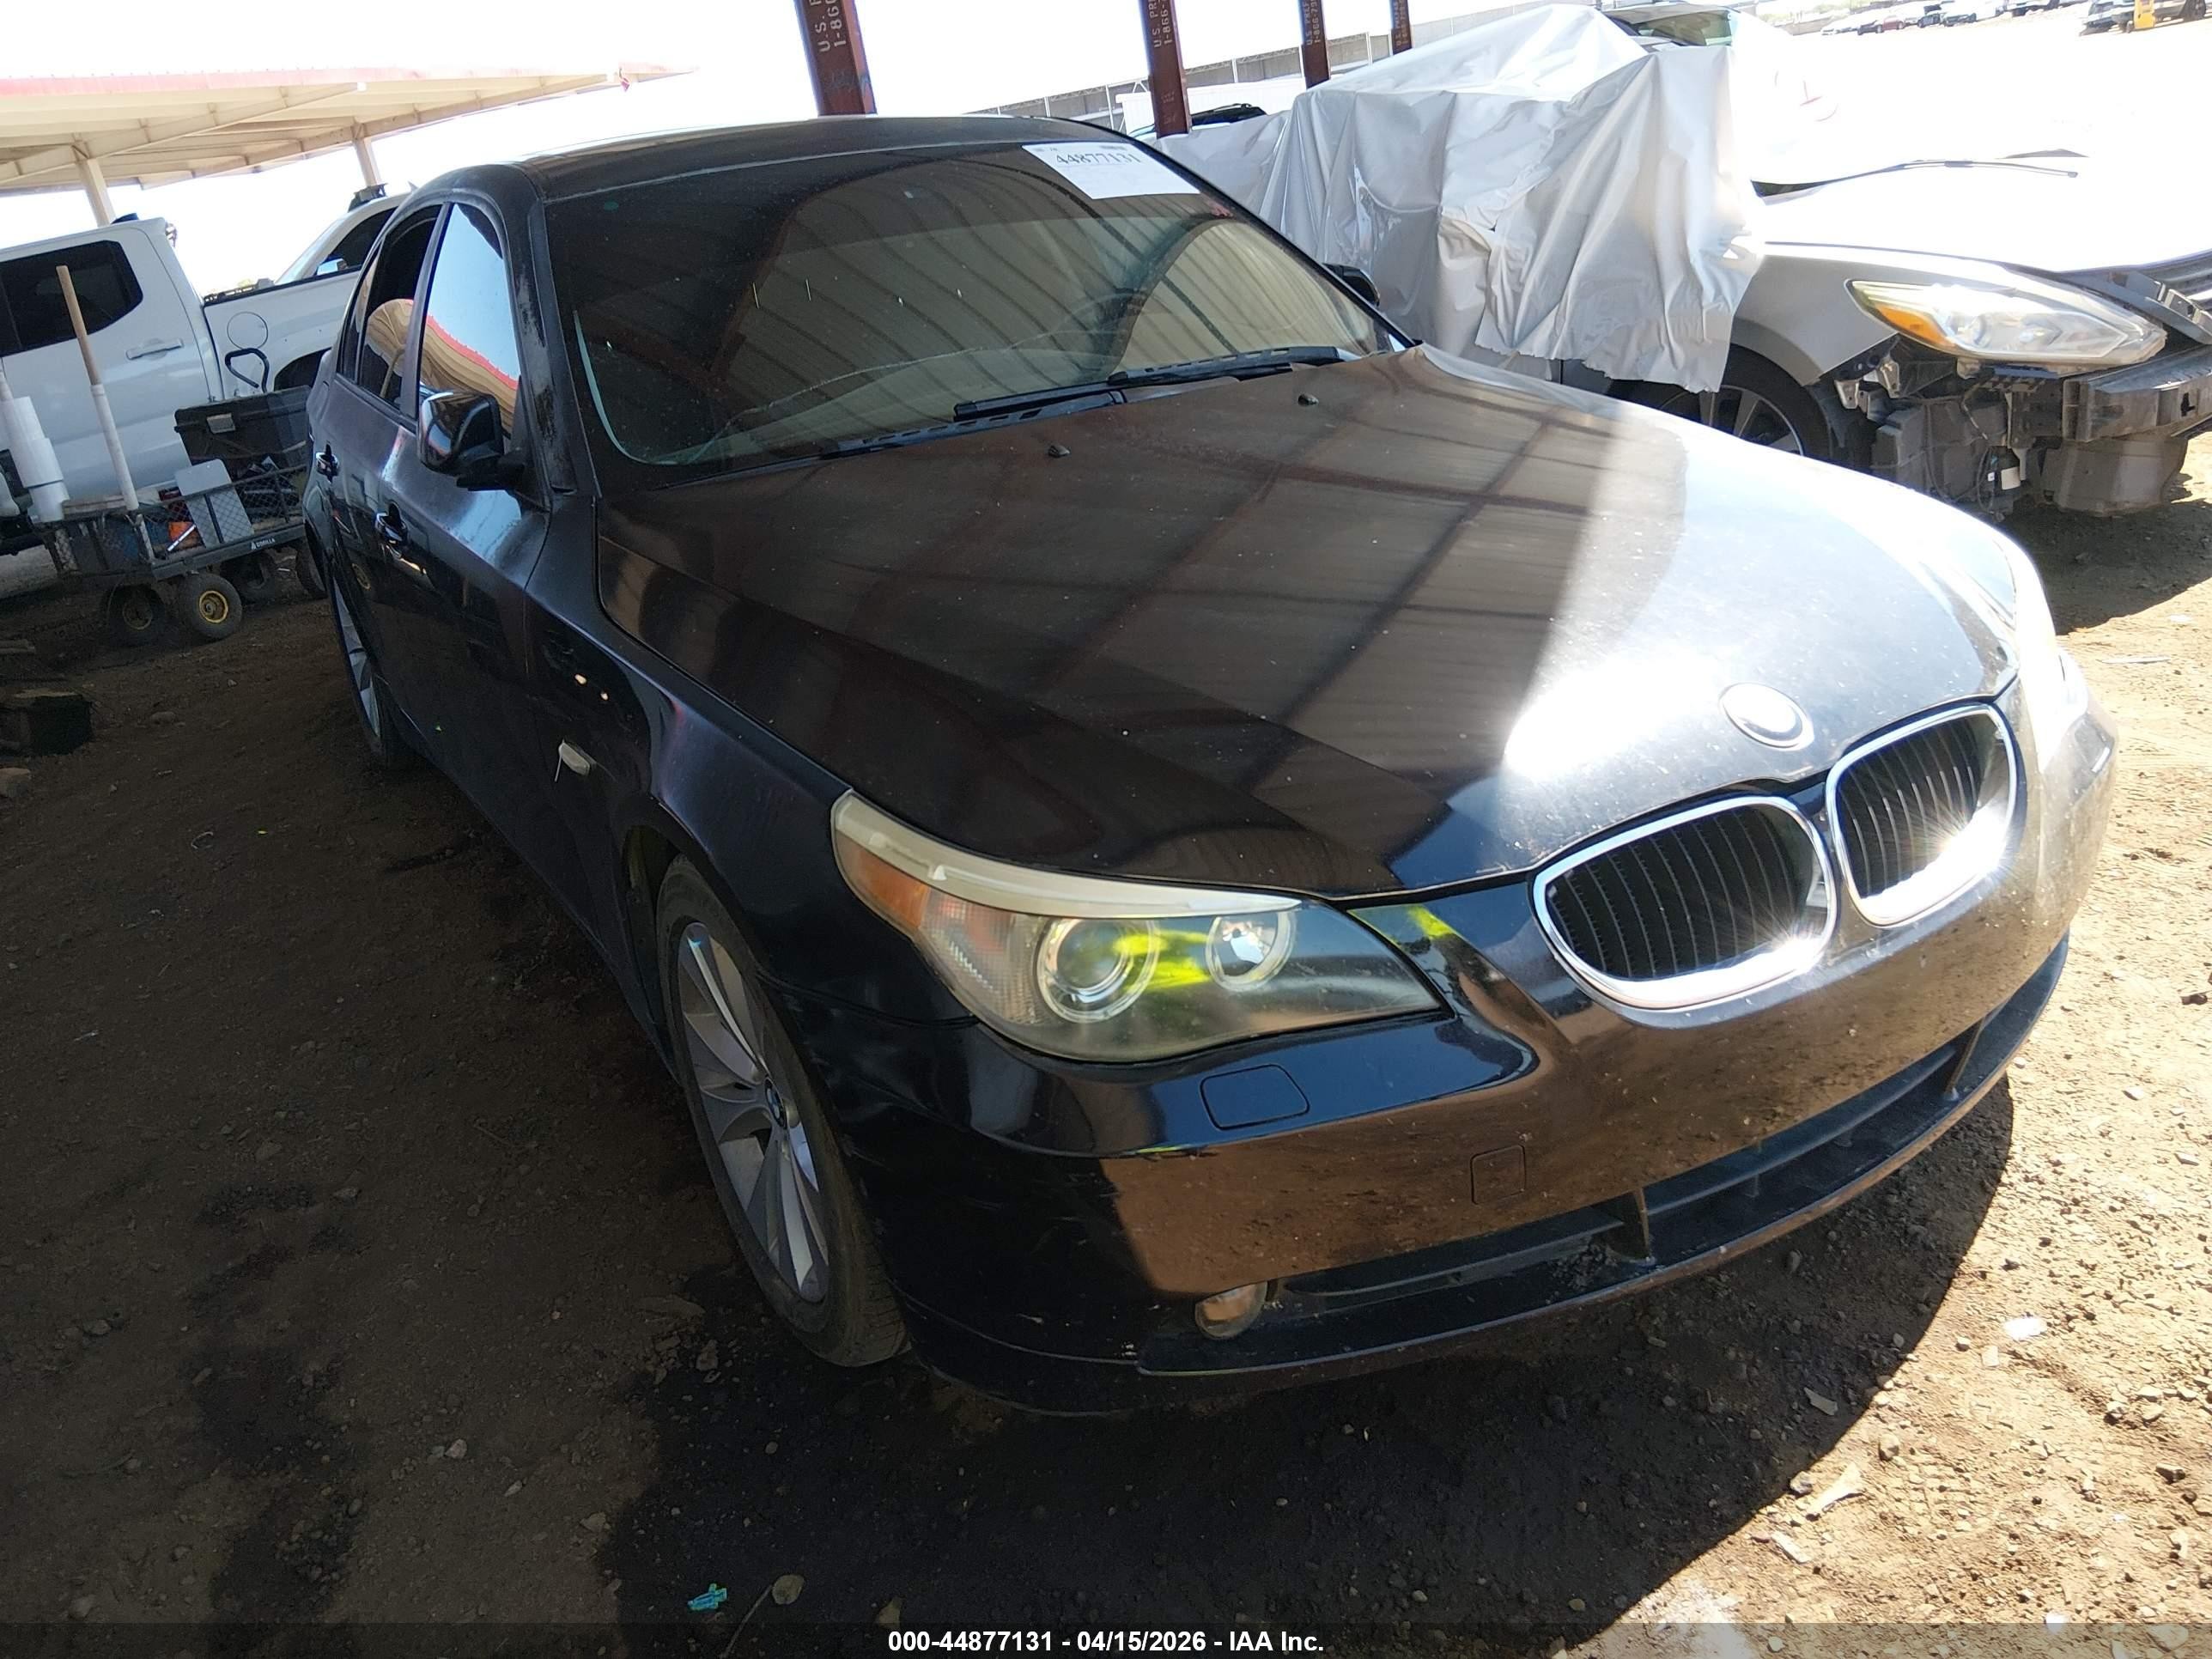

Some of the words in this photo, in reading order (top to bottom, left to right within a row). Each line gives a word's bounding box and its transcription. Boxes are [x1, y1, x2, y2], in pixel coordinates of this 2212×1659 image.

[814, 15, 830, 52] U.S.
[1160, 0, 1172, 44] 1-866-
[1056, 153, 1141, 164] 44877131
